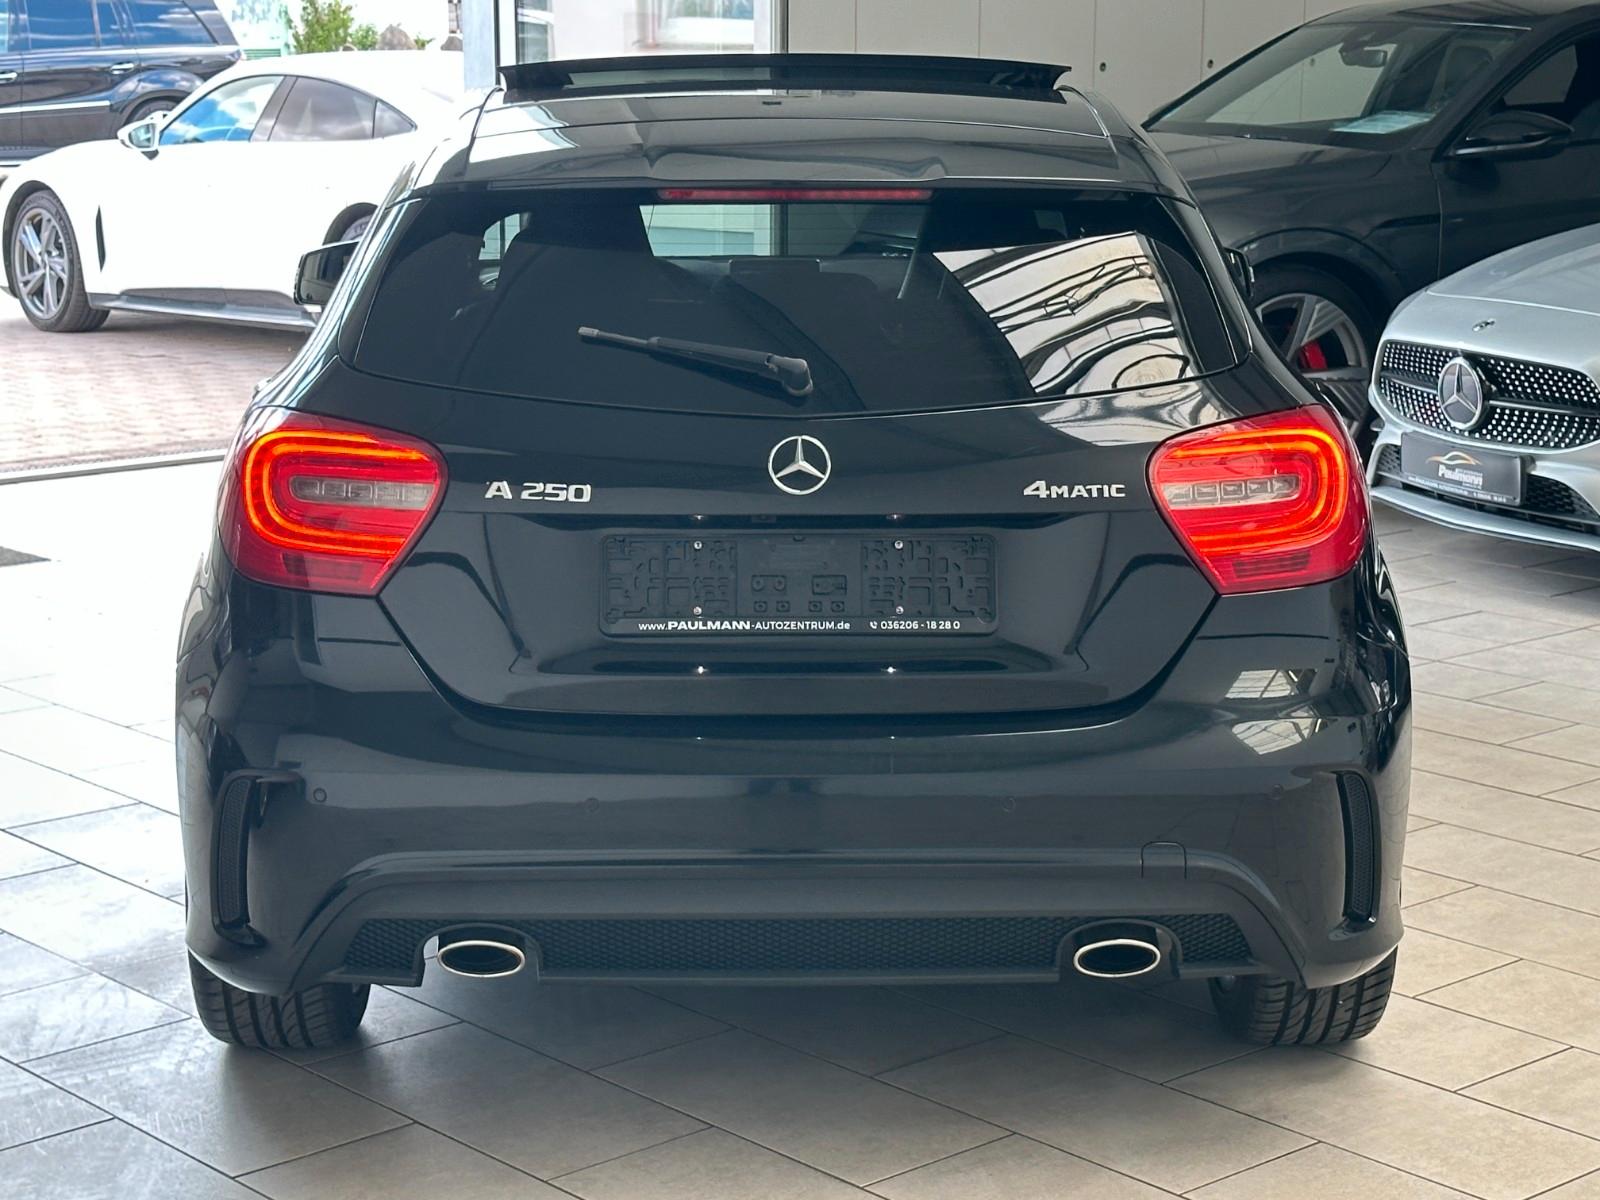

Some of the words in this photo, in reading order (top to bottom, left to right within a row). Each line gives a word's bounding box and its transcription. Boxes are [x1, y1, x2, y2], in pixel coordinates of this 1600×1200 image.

[484, 480, 513, 500] A
[520, 482, 592, 503] 250
[1023, 480, 1126, 499] 4MATIC
[638, 620, 851, 631] www.PAULMANN-AUTOZENTRUM.de
[880, 620, 919, 630] 036206
[926, 620, 938, 630] 18
[938, 620, 952, 630] 28
[952, 620, 961, 630] 0
